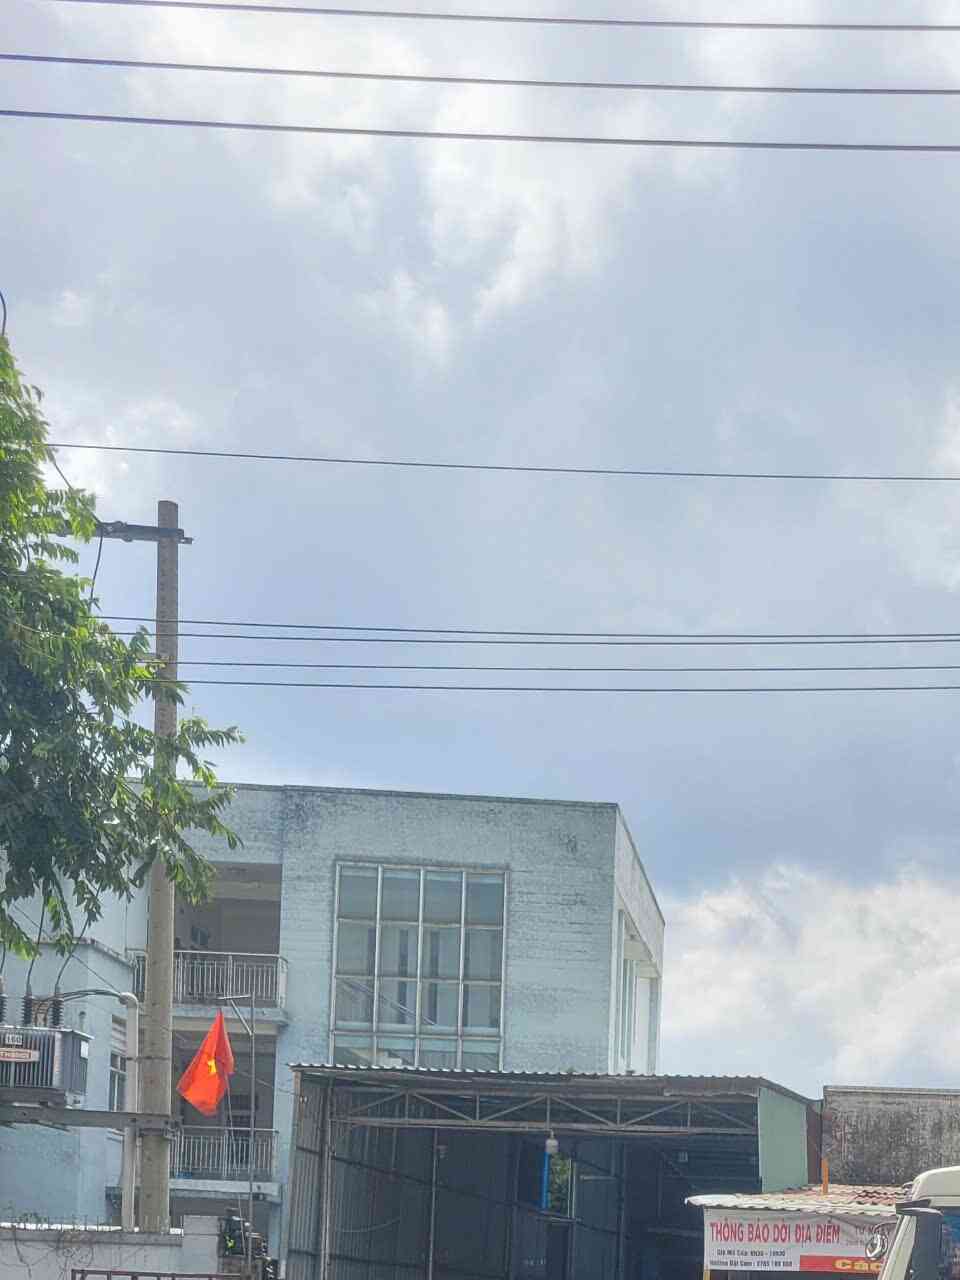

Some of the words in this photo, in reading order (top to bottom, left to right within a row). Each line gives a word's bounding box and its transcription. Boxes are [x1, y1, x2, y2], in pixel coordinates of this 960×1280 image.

[709, 1217, 744, 1243] THÔNG
[747, 1216, 770, 1243] BÁO
[773, 1218, 791, 1243] DỜI
[794, 1222, 812, 1247] ĐỊA
[815, 1218, 841, 1244] ĐIỂM
